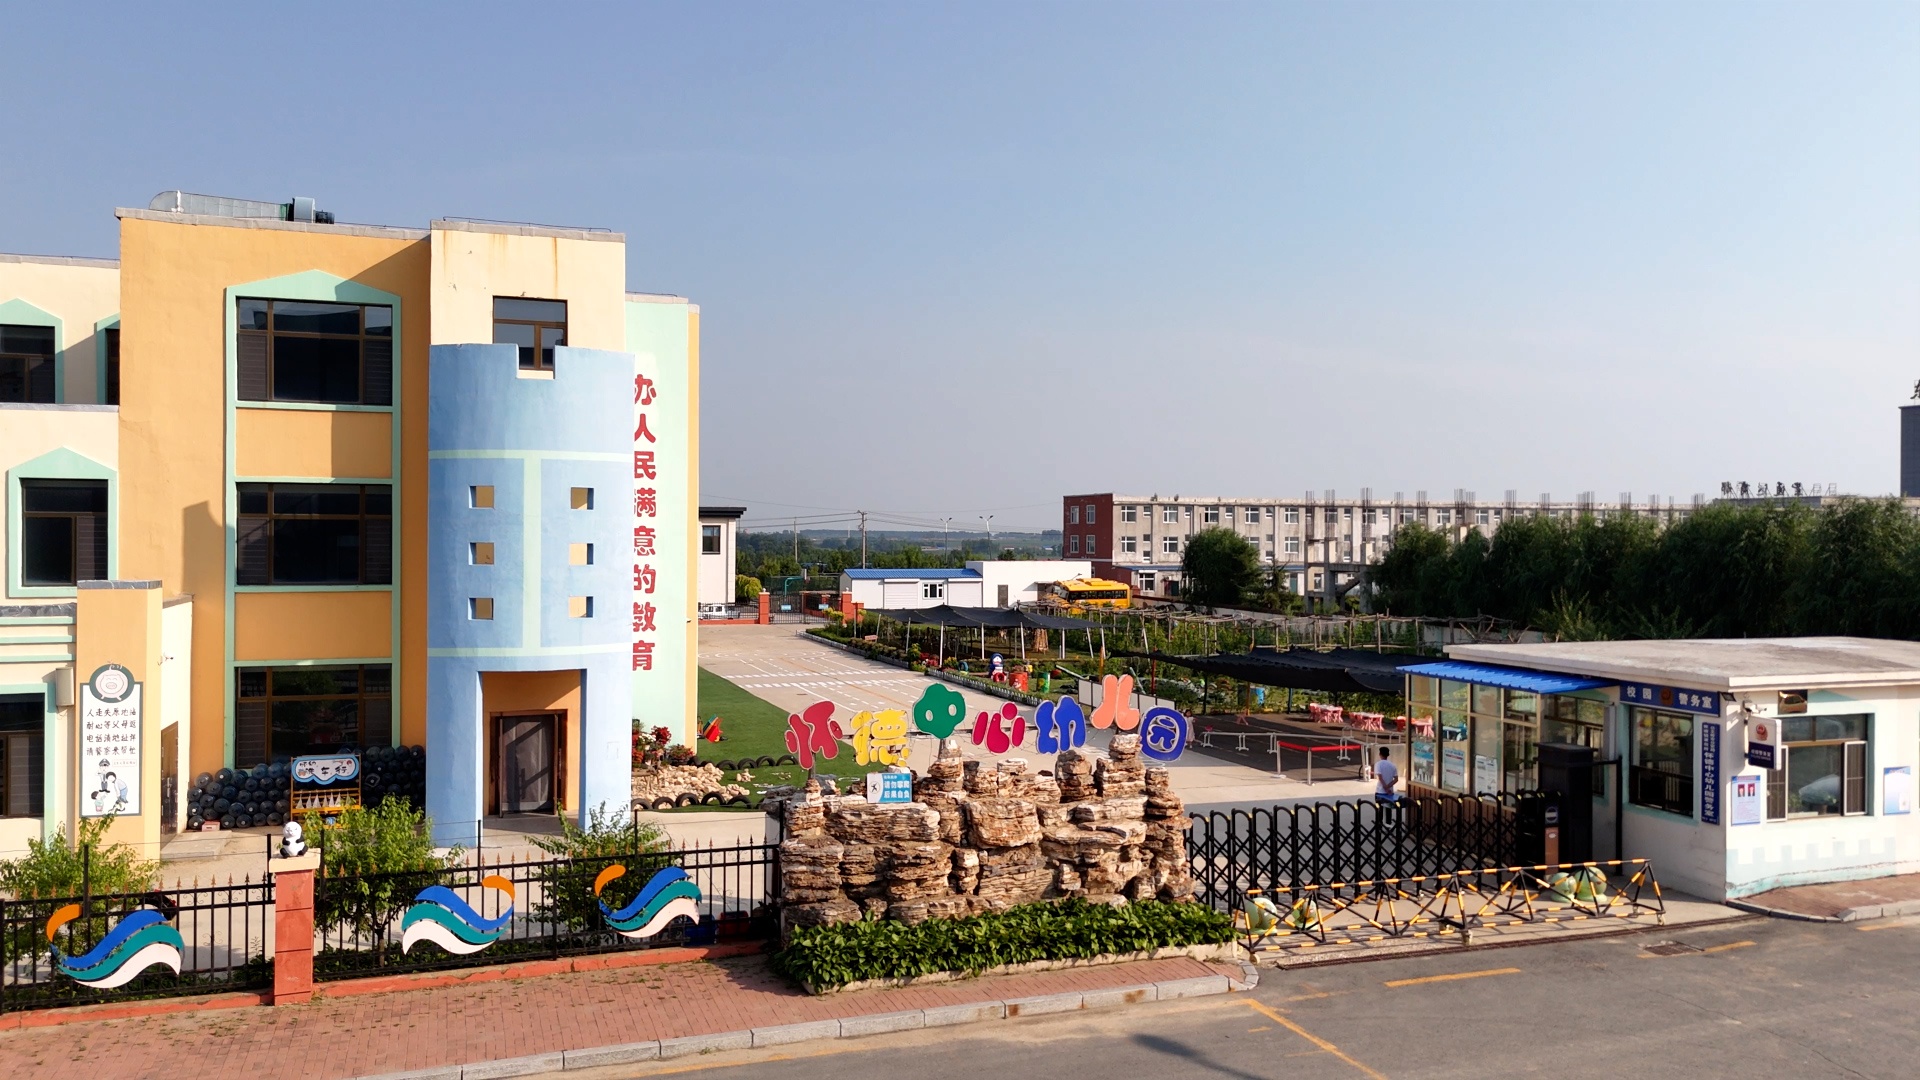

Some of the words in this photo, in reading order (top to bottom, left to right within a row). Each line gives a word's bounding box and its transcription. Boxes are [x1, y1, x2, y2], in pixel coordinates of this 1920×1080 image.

[633, 374, 657, 671] 办人民满意的教育
[1627, 686, 1652, 700] 校园
[1678, 692, 1712, 709] 警务室
[785, 674, 1189, 769] 怀德中心幼儿园
[884, 780, 910, 789] 请勿攀爬
[884, 790, 910, 799] 后果自负
